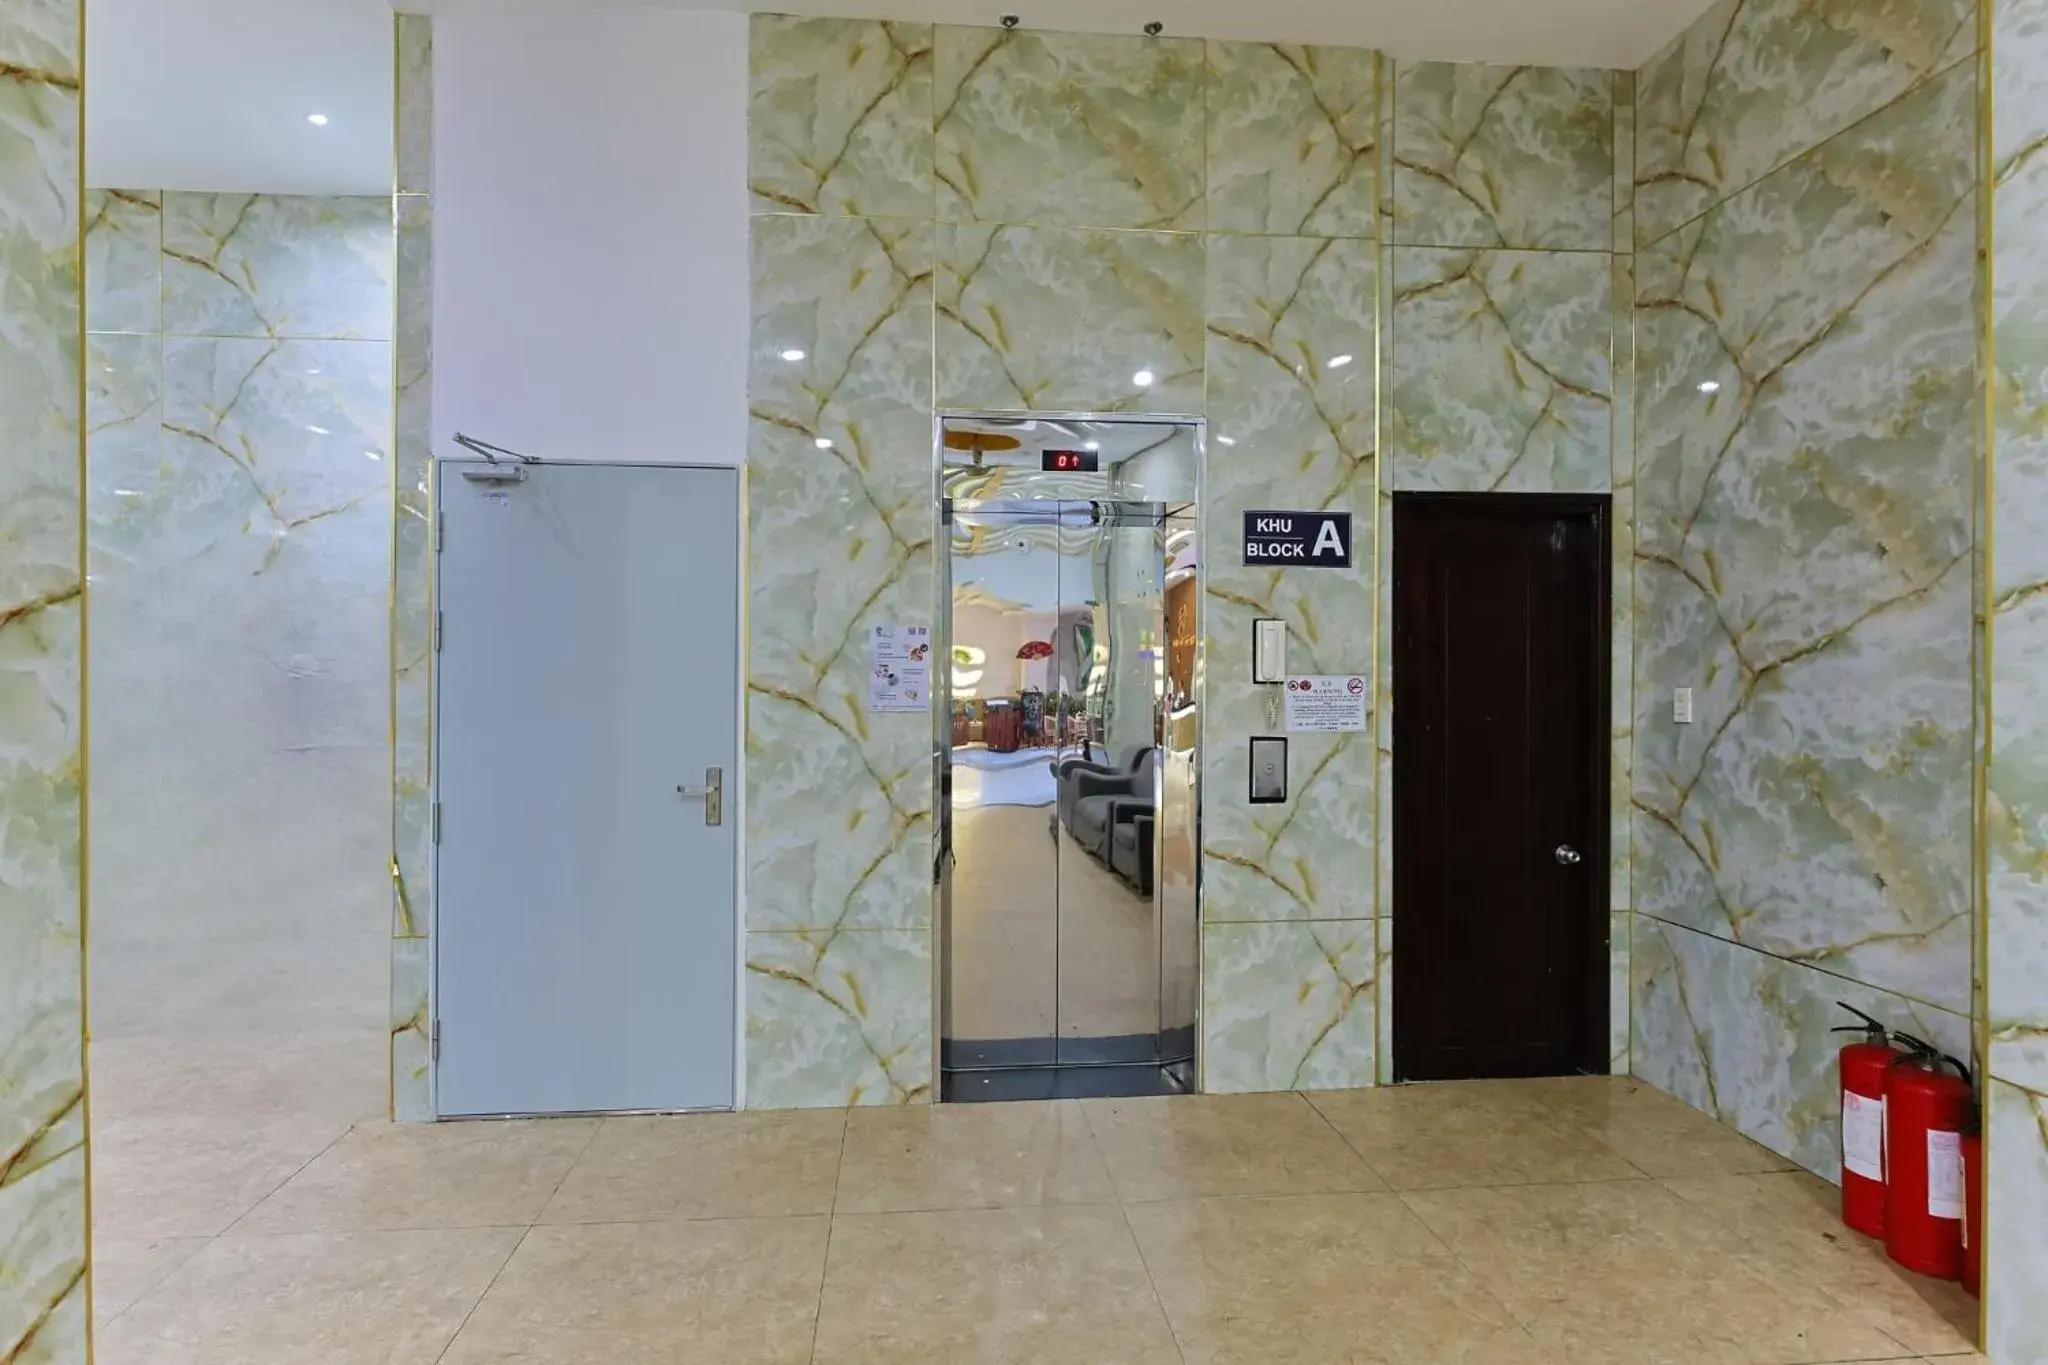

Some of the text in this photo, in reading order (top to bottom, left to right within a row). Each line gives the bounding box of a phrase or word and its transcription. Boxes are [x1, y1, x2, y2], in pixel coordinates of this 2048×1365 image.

[1247, 519, 1345, 557] BLOCK A
[1256, 518, 1292, 533] KHU
